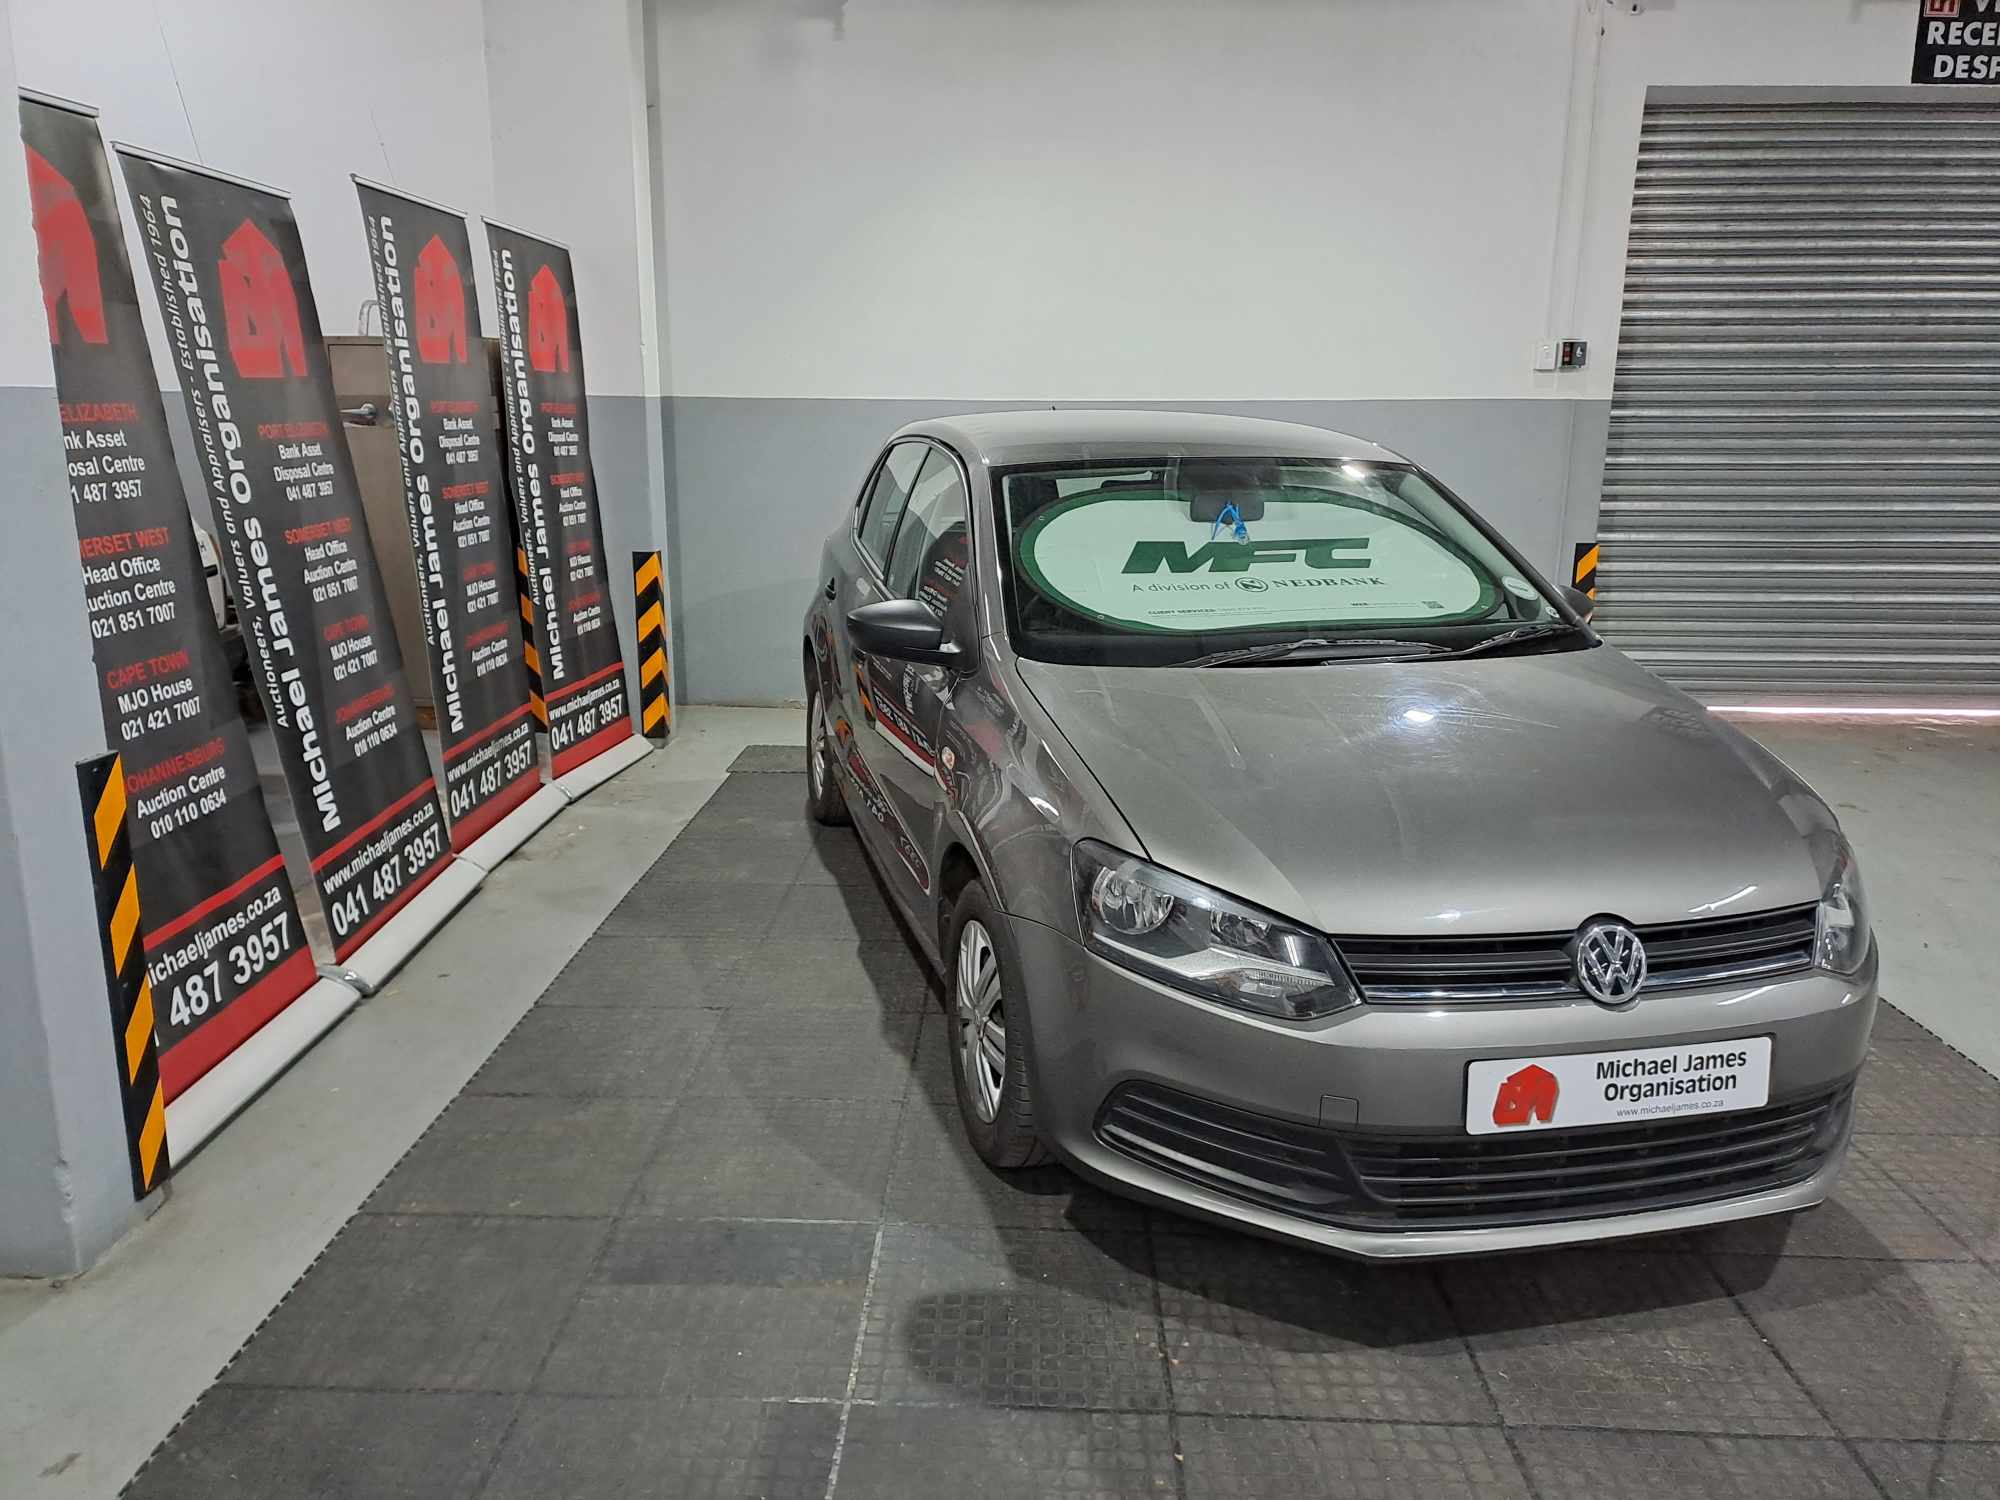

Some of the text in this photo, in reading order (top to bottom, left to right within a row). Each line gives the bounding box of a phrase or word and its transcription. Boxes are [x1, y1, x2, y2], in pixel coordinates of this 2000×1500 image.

[139, 193, 162, 247] 1964
[152, 254, 194, 371] Established
[86, 429, 128, 448] Asset
[191, 389, 226, 493] Appraisers
[278, 443, 301, 460] Bank
[102, 455, 146, 475] Centre
[273, 463, 311, 483] Disposal
[380, 215, 464, 733] Michael James Organisation
[501, 249, 565, 680] Michael James Organisation
[83, 482, 107, 503] 487
[112, 479, 143, 500] 3957
[161, 195, 341, 833] Michael James Organisation
[216, 495, 236, 535] and
[82, 556, 161, 586] Head Office
[231, 540, 257, 609] Valuers
[304, 565, 334, 584] Auction
[1121, 538, 1372, 574] MFC
[87, 580, 176, 613] uction Centre
[1132, 576, 1385, 592] A division of NEDBANK
[91, 601, 176, 639] 021 851 7007
[347, 634, 373, 653] House
[107, 650, 191, 689] CAPE TOWN
[252, 615, 289, 728] Auctioneers,
[117, 677, 193, 715] MJO House
[548, 679, 620, 720] www.michaeljames.co.za
[121, 696, 201, 741] 021 421 7007
[345, 716, 373, 741] Auction
[551, 694, 622, 750] 041 487 3957
[447, 722, 529, 782] www.michaeljames.co.za
[137, 766, 226, 819] Auction Centre
[450, 740, 531, 817] 041 487 3957
[150, 788, 227, 839] 010 110 0634
[323, 802, 434, 895] www.michaeljames.co.za
[331, 822, 441, 936] 041 487 3957
[148, 886, 282, 988] ichaeljames.co.za
[170, 911, 291, 1027] 487 3957
[1596, 1050, 1747, 1081] Michael James
[1604, 1072, 1737, 1103] Organisation
[1616, 1098, 1724, 1118] www.michaeljames.co.za
